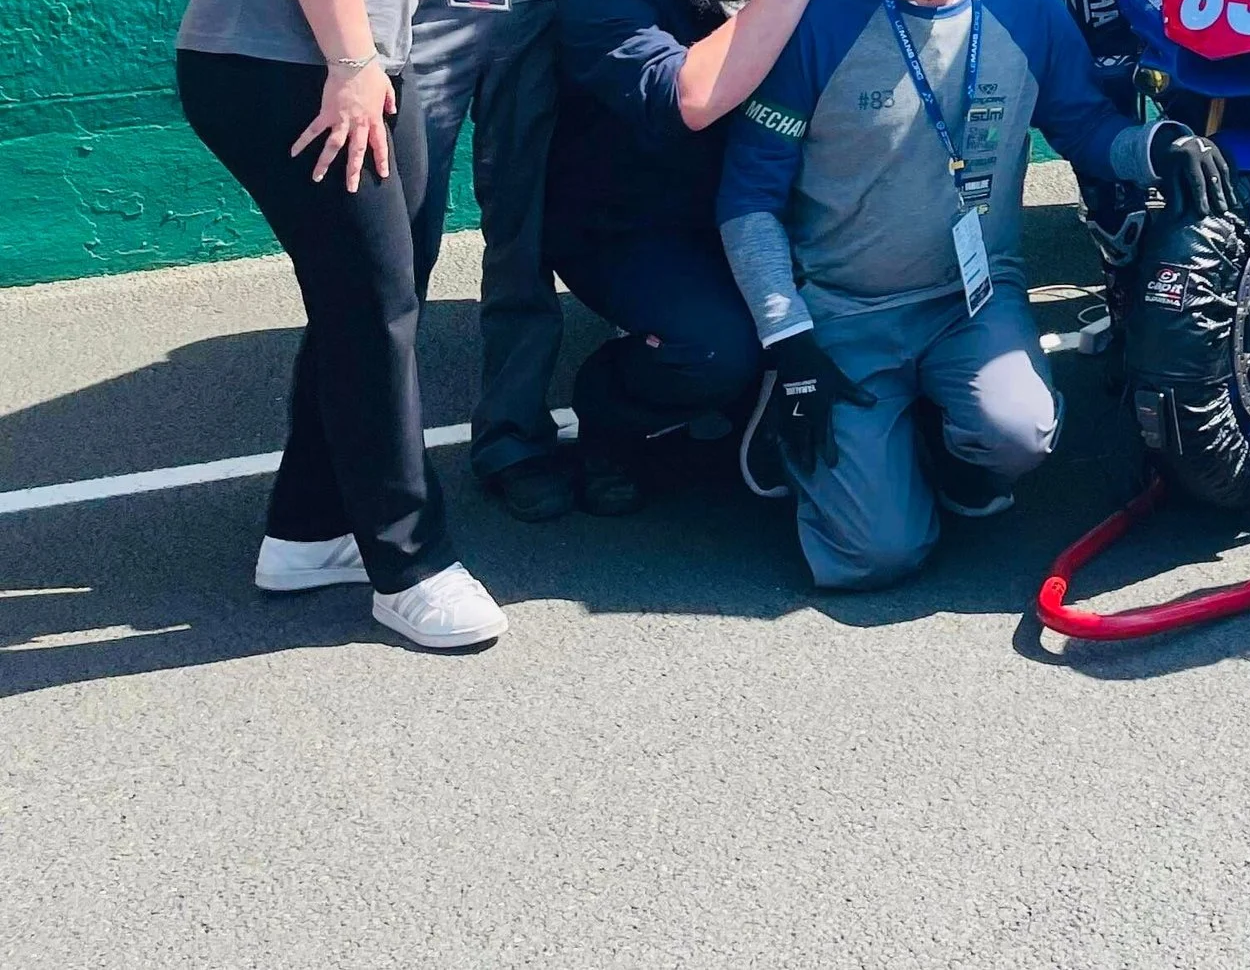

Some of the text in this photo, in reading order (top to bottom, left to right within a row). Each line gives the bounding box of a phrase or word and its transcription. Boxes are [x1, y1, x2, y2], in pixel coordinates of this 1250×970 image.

[895, 20, 915, 59] LEMANS
[970, 33, 979, 74] LEMANS
[858, 88, 895, 110] #83
